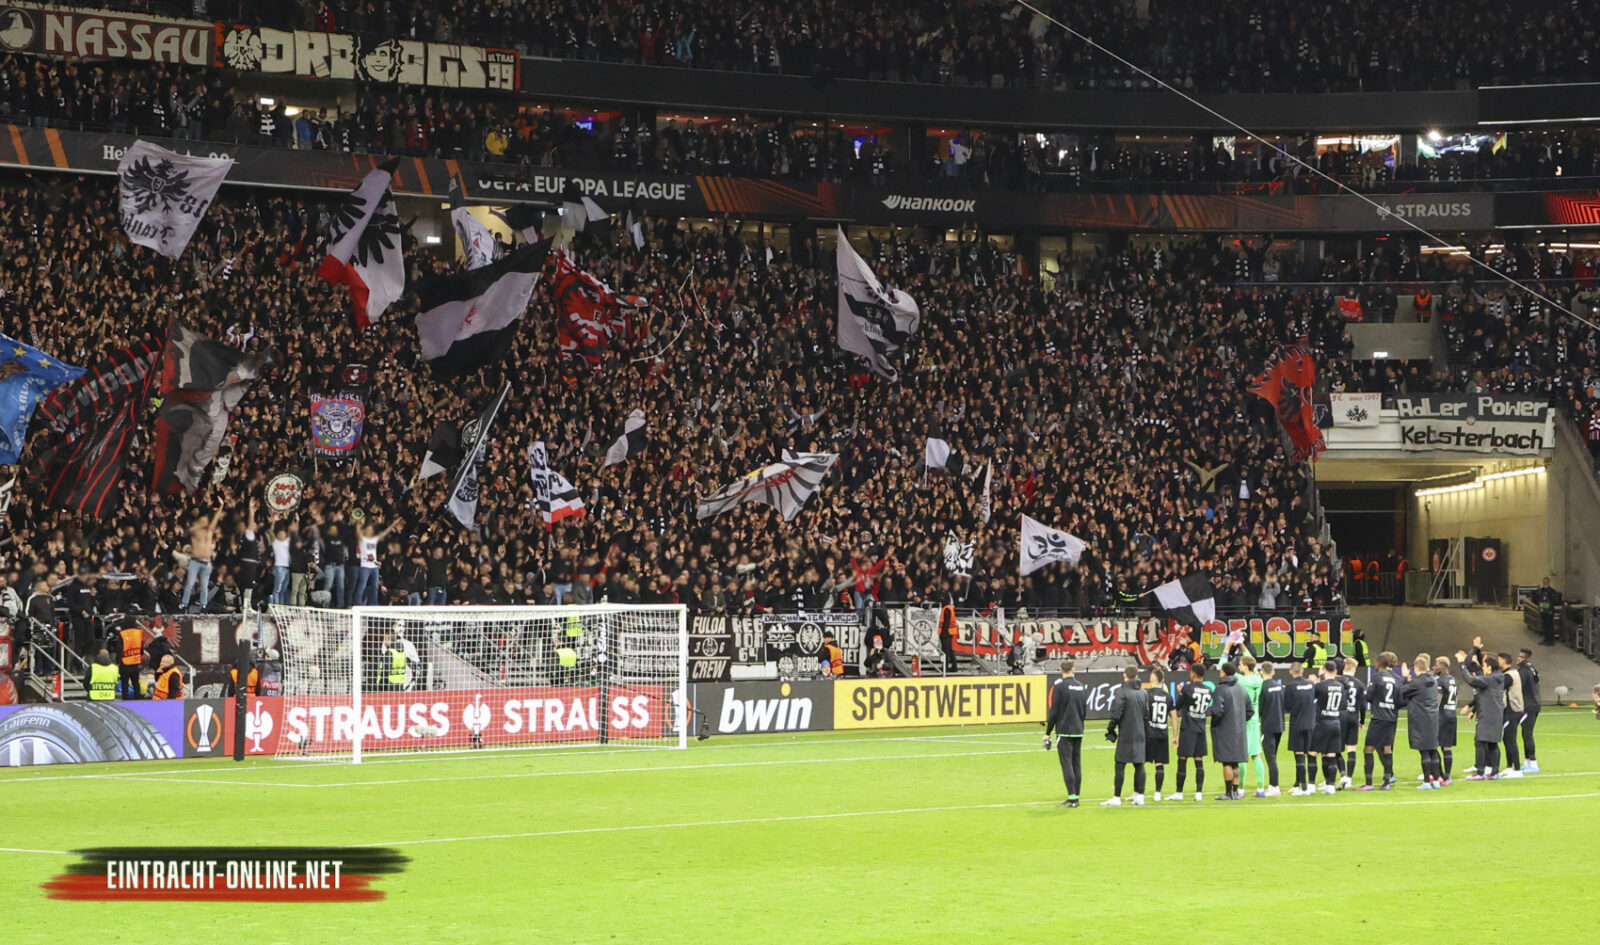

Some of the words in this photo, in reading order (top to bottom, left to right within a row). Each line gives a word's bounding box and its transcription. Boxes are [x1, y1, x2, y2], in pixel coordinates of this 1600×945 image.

[45, 14, 209, 66] NASSAU
[488, 64, 515, 90] 99
[613, 180, 687, 200] LEAGUE
[1395, 203, 1472, 217] STRAUSS
[1478, 396, 1549, 417] Power
[691, 616, 727, 635] FULDA
[738, 647, 759, 662] 64
[691, 660, 727, 679] CREW
[852, 682, 1031, 721] SPORTWETTEN
[1189, 692, 1211, 714] 36
[1326, 691, 1342, 711] 10
[1384, 683, 1394, 703] 2
[503, 695, 650, 734] STRAUSS
[718, 682, 813, 734] bwin
[1151, 701, 1168, 723] 19
[286, 702, 450, 743] STRAUSS
